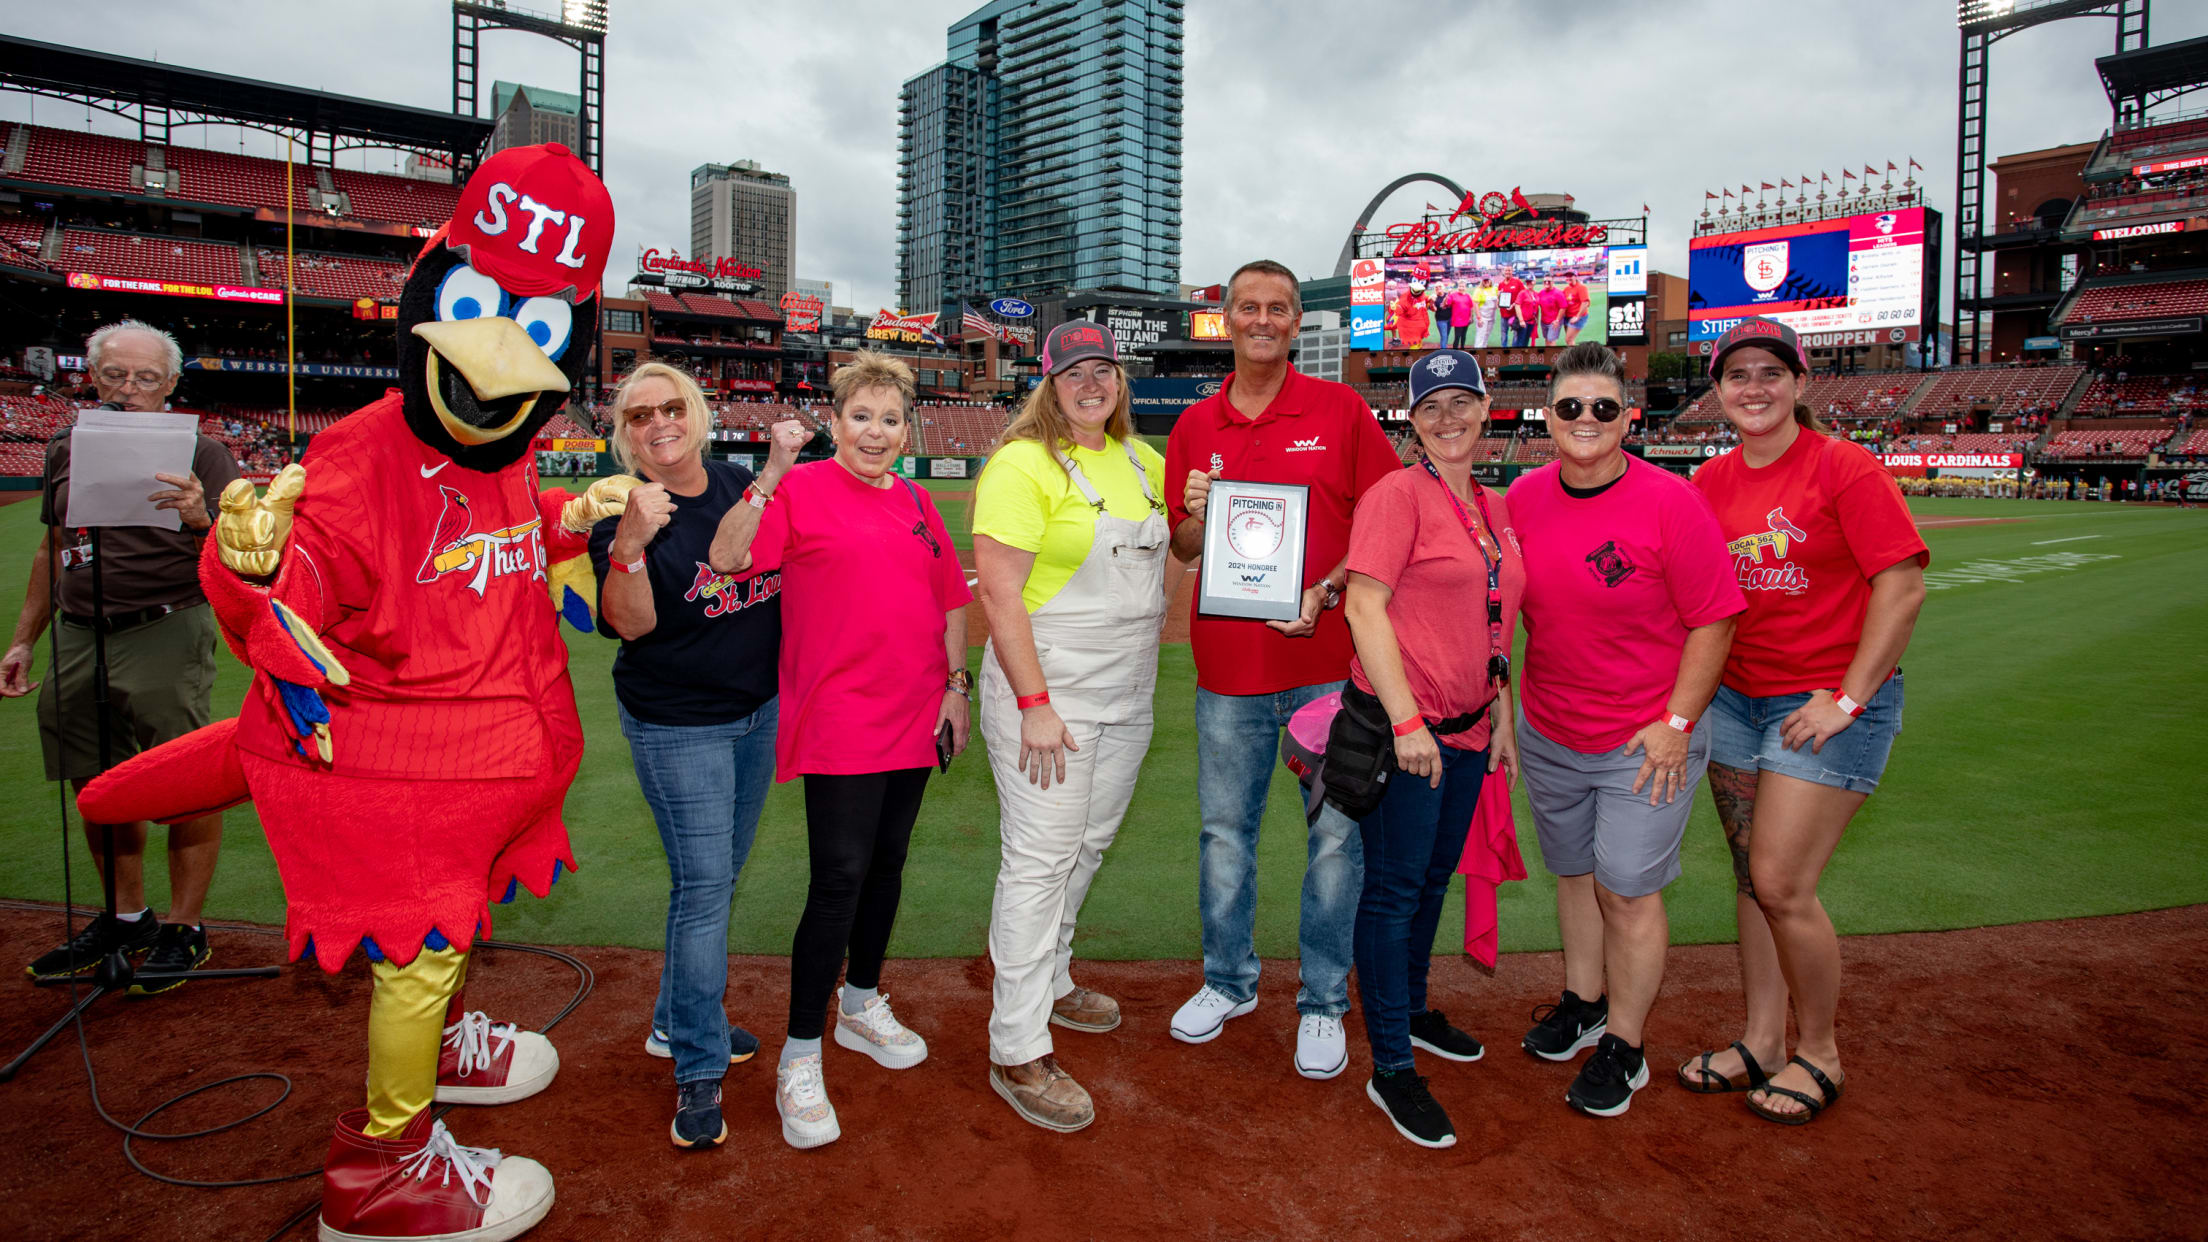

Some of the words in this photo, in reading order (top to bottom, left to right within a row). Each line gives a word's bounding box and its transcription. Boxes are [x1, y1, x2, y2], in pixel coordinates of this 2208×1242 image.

[1712, 212, 1776, 232] WORLD
[1781, 195, 1898, 222] CHAMPIONS
[474, 182, 586, 268] STL
[2099, 222, 2177, 240] WELCOME
[1386, 218, 1608, 257] Budweiser
[642, 248, 707, 273] Cardinals
[708, 256, 762, 279] Nation
[103, 278, 120, 288] FOR
[121, 279, 138, 289] THE
[138, 281, 163, 291] FANS.
[163, 284, 179, 293] FOR
[180, 285, 196, 294] THE
[196, 286, 214, 296] LOU.
[217, 287, 249, 298] Cardinals
[713, 280, 751, 291] ROOFTOP
[780, 291, 824, 316] Bally
[1000, 300, 1026, 314] Ford
[1609, 301, 1645, 322] stl
[1878, 311, 1888, 320] GO
[1891, 310, 1902, 319] GO
[1904, 309, 1915, 318] GO
[868, 312, 938, 329] Budweier
[1108, 317, 1142, 330] FROM
[1144, 320, 1168, 332] THE
[1352, 317, 1383, 331] Cutter
[1609, 322, 1644, 330] TODAY
[867, 328, 899, 340] BREW
[1114, 330, 1130, 341] OU
[1133, 331, 1159, 343] AND
[1800, 330, 1876, 347] ROUPPEN
[2070, 329, 2092, 337] Mercy
[230, 360, 311, 373] WEBSTER
[564, 440, 596, 448] DOBBS
[1648, 447, 1698, 455] Schnucks
[1885, 455, 1922, 466] LOUIS
[1927, 454, 2011, 467] CARDINALS
[1232, 499, 1274, 510] PITCHING
[1730, 540, 1755, 551] LOCAL
[1757, 535, 1773, 544] 562
[1247, 564, 1277, 572] HONOREE
[1735, 556, 1808, 591] Louis
[704, 585, 742, 618] St.
